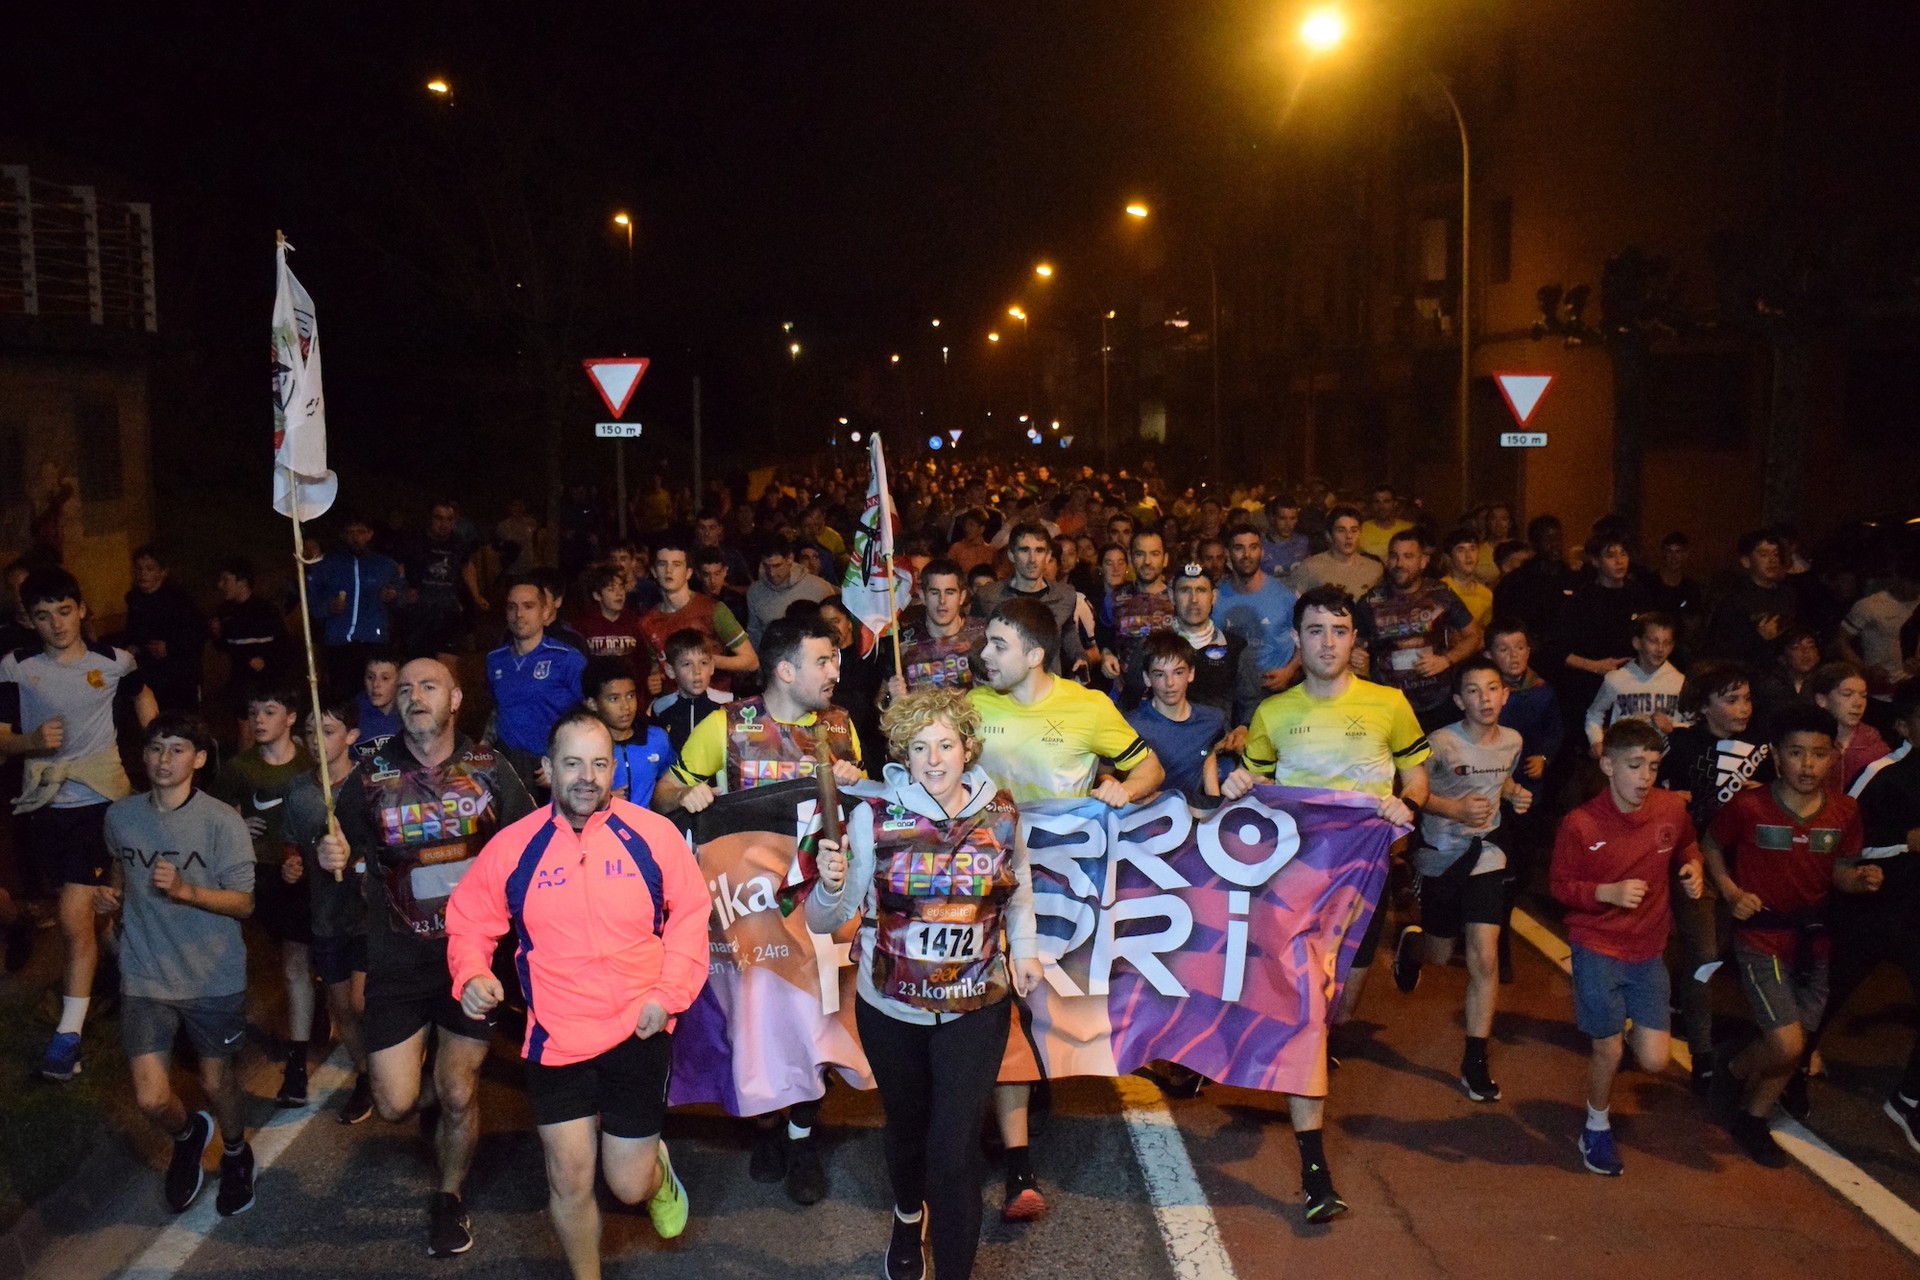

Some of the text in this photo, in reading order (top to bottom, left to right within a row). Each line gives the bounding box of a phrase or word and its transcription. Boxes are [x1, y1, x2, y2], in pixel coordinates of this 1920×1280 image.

[602, 425, 636, 435] 150 m
[1507, 435, 1541, 445] 150 m
[830, 722, 847, 734] eitb
[474, 752, 494, 762] eitb
[741, 760, 817, 780] HARR
[1717, 743, 1769, 803] adidas
[708, 872, 780, 931] ika
[919, 927, 974, 958] 1472
[753, 943, 789, 962] 24ra
[898, 977, 987, 1000] 23.korrika
